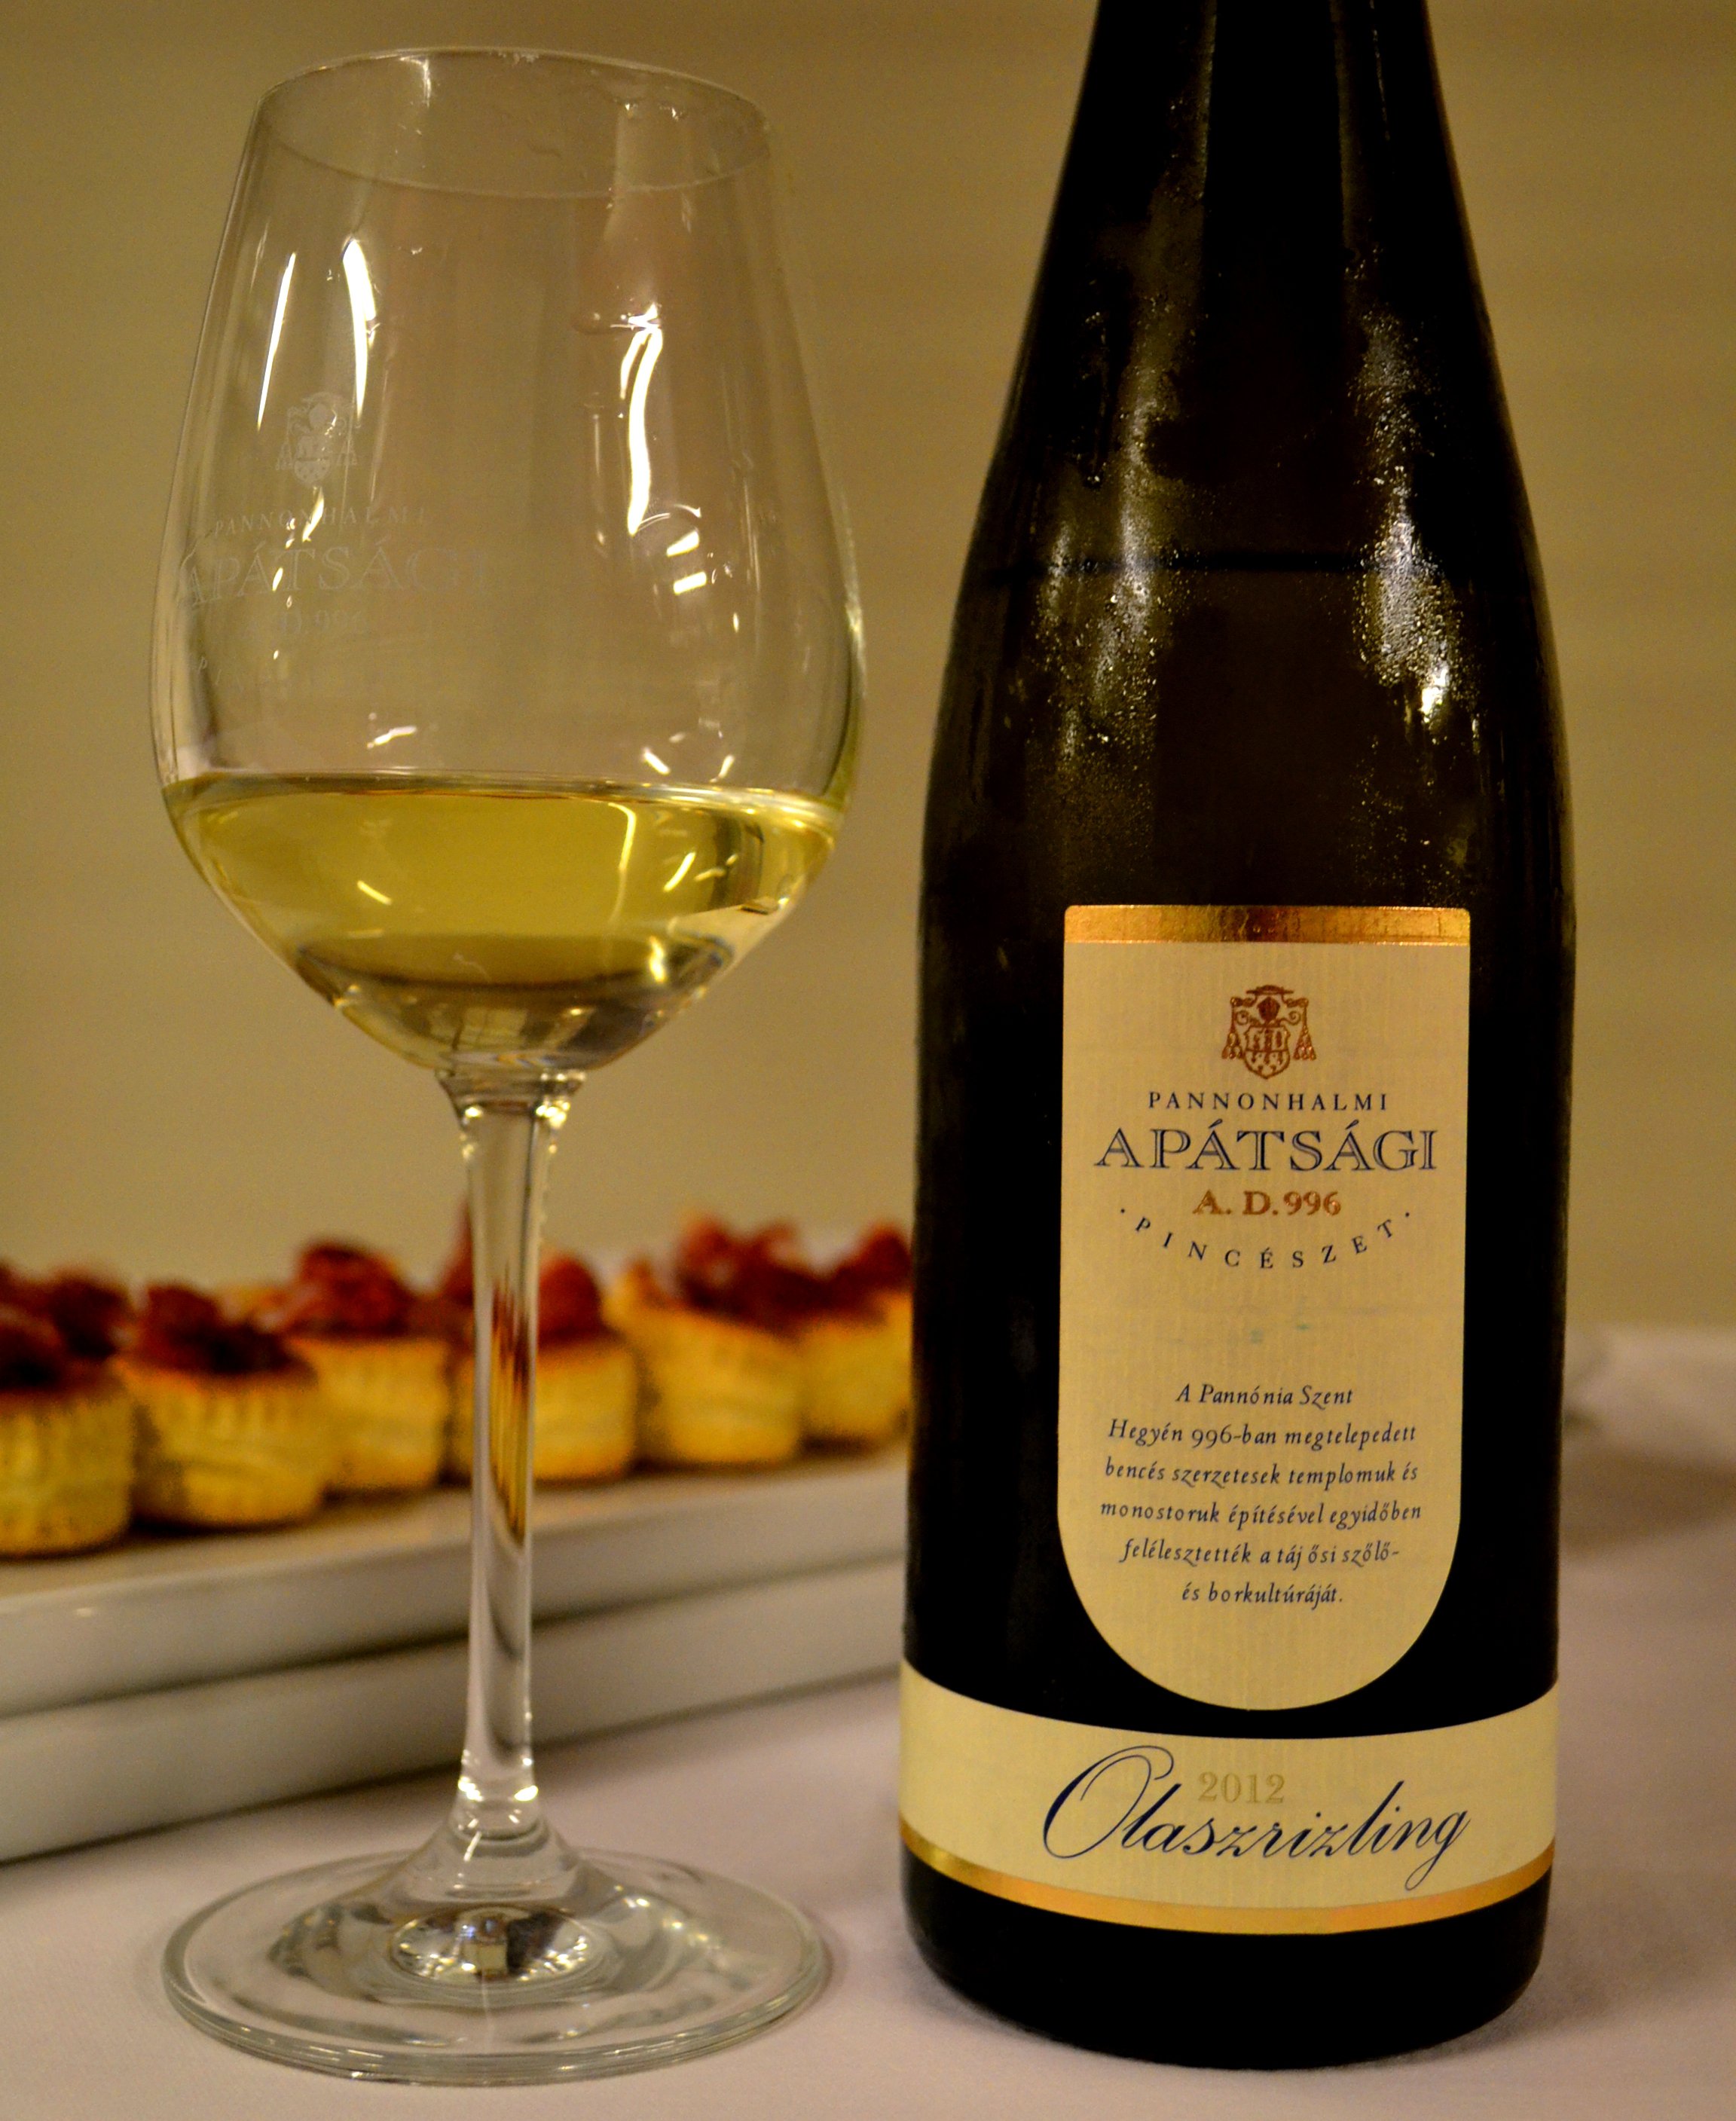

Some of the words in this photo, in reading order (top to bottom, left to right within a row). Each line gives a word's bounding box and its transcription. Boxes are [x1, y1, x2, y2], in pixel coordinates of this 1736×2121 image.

[1148, 1091, 1386, 1111] PANNONHALMI
[1094, 1117, 1438, 1172] APÁTSÁGI
[1175, 1383, 1190, 1403] A
[1199, 1383, 1294, 1405] Pannónia
[1299, 1384, 1353, 1410] Szent
[1108, 1418, 1183, 1447] Hegyén
[1191, 1423, 1276, 1449] 996-ban
[1285, 1421, 1416, 1452] megtelepedett
[1105, 1456, 1166, 1481] bencés
[1172, 1462, 1280, 1489] szerzetesek
[1288, 1460, 1395, 1492] templomuk
[1401, 1461, 1418, 1481] és
[1101, 1501, 1220, 1523] monostoruk
[1228, 1502, 1325, 1531] építésével
[1329, 1499, 1421, 1530] egyidőben
[1118, 1537, 1252, 1568] felélesztették
[1260, 1551, 1271, 1563] a
[1276, 1545, 1302, 1571] táj
[1307, 1544, 1336, 1564] ősi
[1342, 1539, 1399, 1568] szőlő-
[1181, 1582, 1200, 1601] és
[1208, 1581, 1343, 1611] borkultúráját.
[1198, 1772, 1286, 1805] 2012
[1042, 1744, 1472, 1891] Olaszrizling
